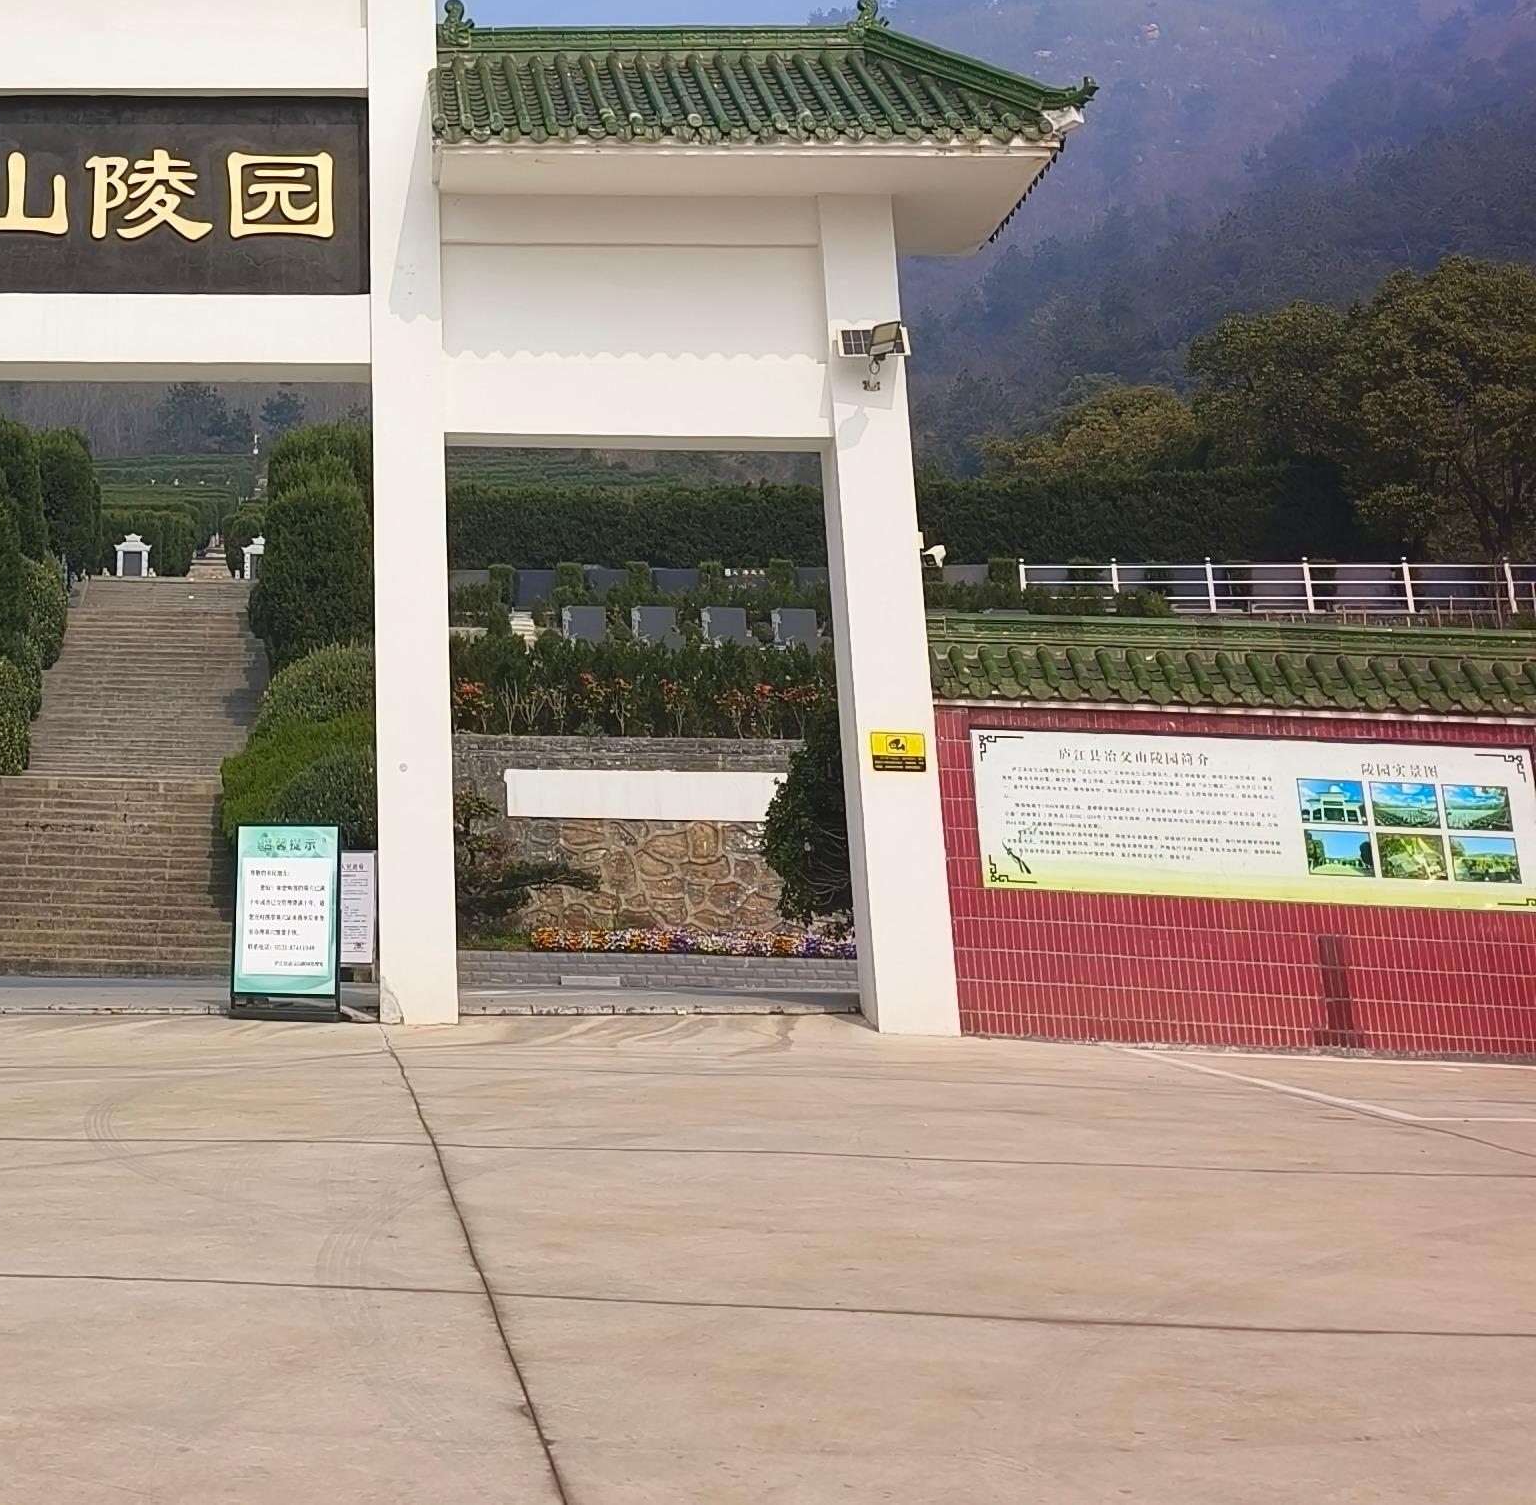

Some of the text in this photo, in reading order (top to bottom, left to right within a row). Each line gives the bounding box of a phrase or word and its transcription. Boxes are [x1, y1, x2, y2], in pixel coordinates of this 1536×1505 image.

[1059, 747, 1209, 767] 庐江县冶父山陵园简介
